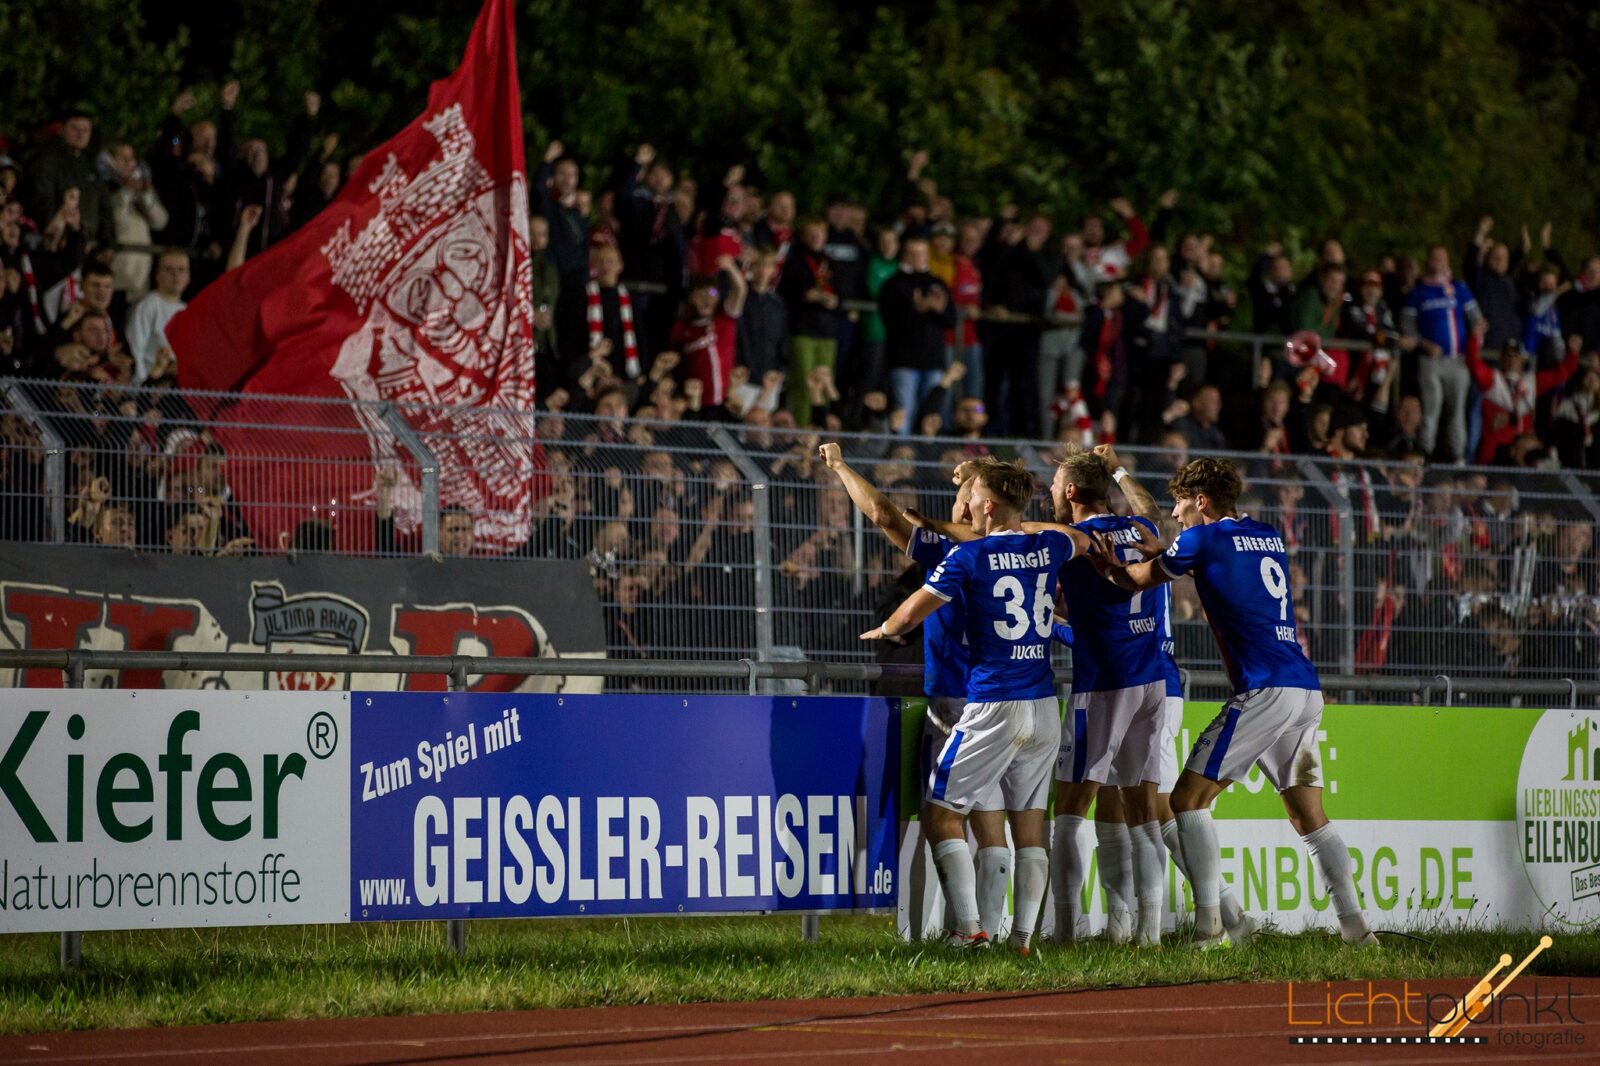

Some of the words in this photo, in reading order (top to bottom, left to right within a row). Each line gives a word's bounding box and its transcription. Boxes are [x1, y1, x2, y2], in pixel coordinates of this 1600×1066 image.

[1232, 535, 1286, 553] ENERGIE
[988, 547, 1051, 571] ENERGIE
[1260, 556, 1288, 621] 9
[992, 572, 1055, 641] 36
[263, 607, 316, 635] ULTIMA
[360, 756, 412, 802] Zum
[417, 722, 478, 783] Spiel
[483, 707, 521, 754] mit
[1575, 877, 1588, 892] Das
